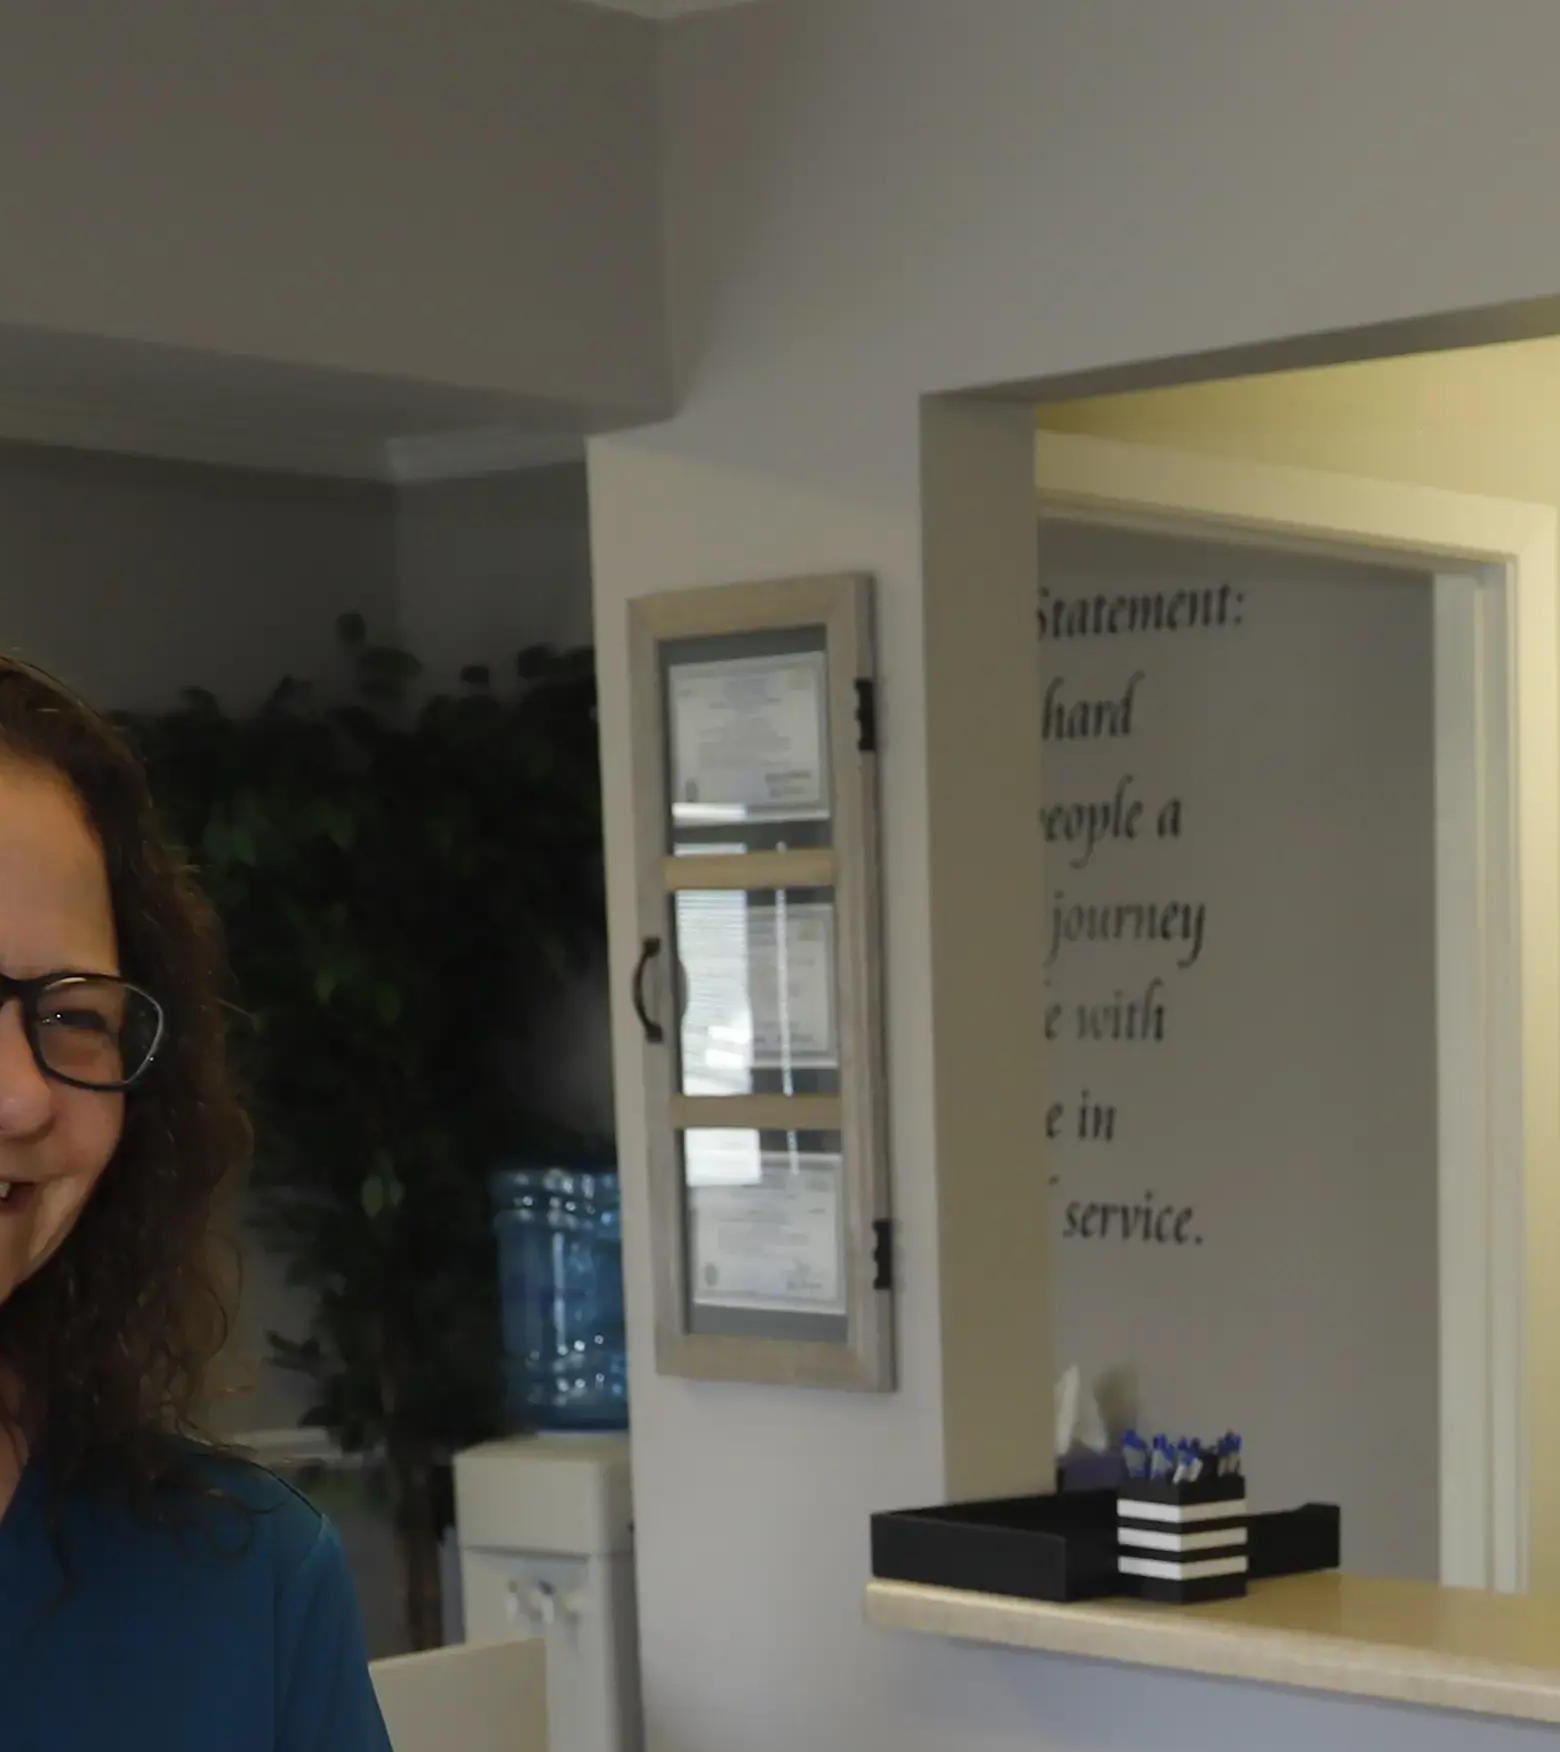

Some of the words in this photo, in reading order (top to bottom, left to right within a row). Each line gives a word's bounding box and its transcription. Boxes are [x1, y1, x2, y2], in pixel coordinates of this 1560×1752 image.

[1041, 669, 1145, 741] hard
[1038, 773, 1143, 870] eople
[1156, 798, 1182, 840] a
[1042, 889, 1206, 970] journey
[1077, 976, 1166, 1042] with
[1078, 1088, 1117, 1142] in
[1062, 1189, 1204, 1246] service.
